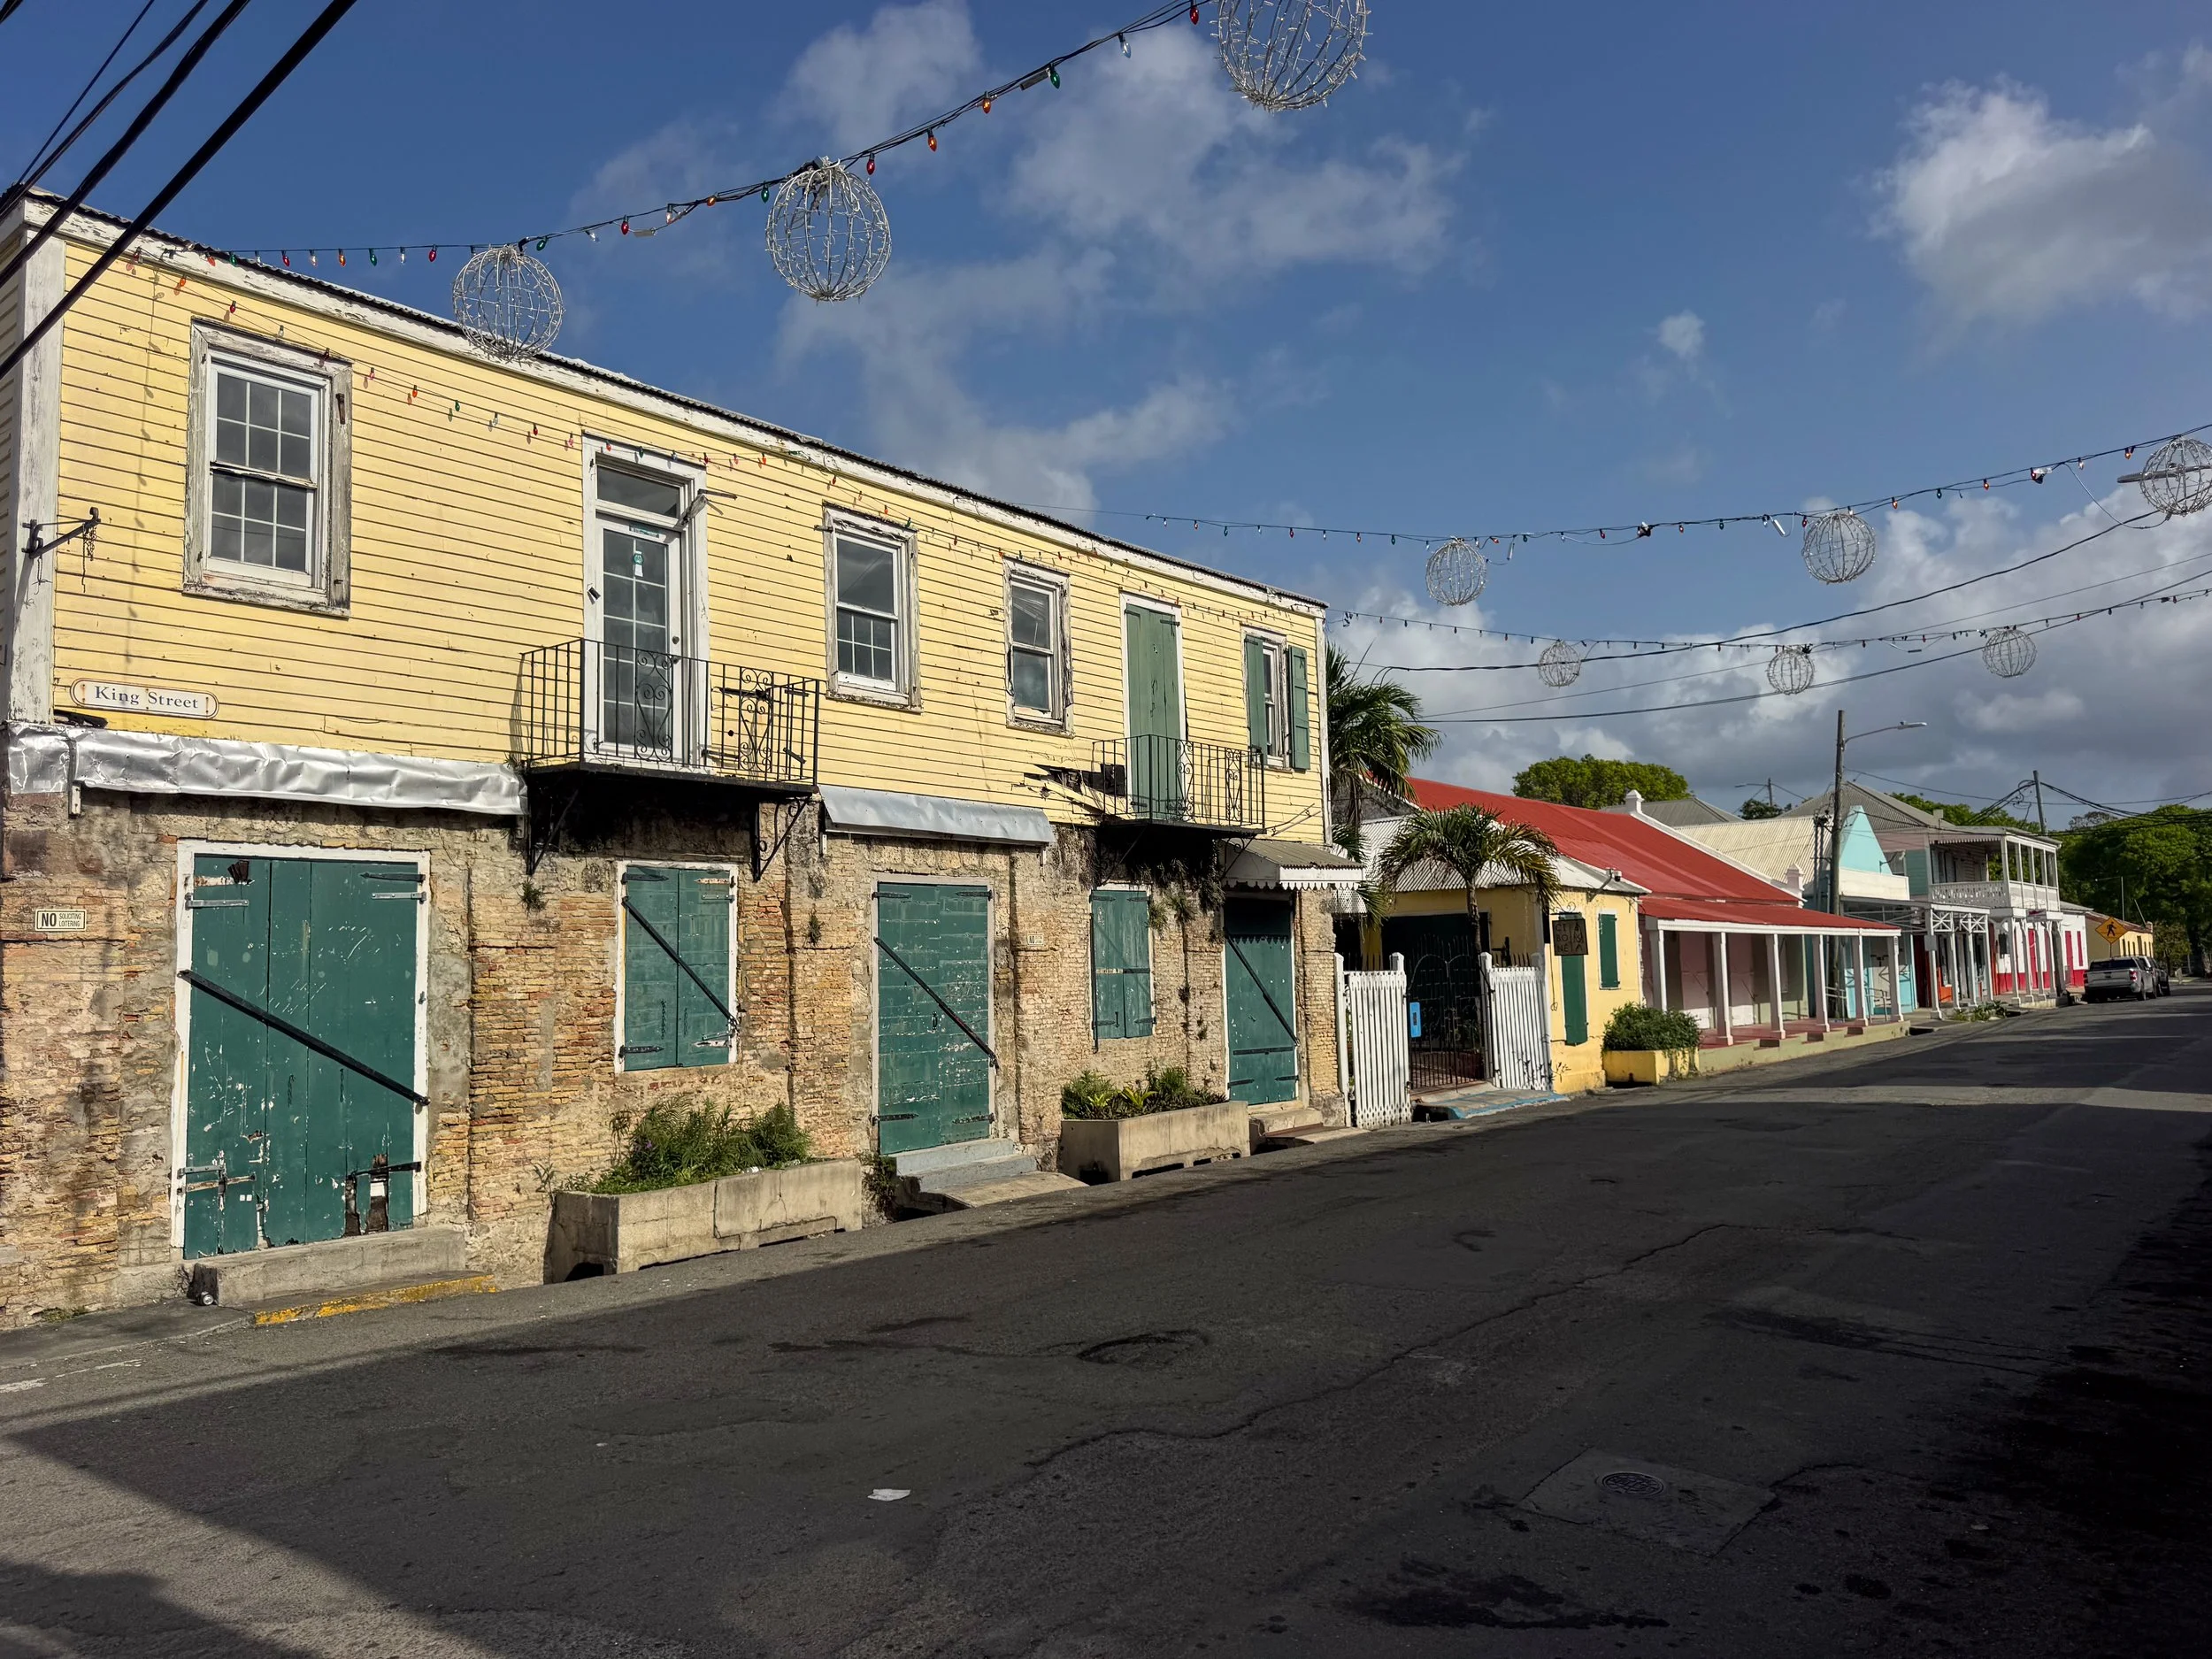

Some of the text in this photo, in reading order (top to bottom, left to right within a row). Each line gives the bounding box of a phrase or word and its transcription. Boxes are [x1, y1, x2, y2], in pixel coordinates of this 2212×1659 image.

[95, 685, 198, 709] King Street
[42, 912, 57, 927] NO
